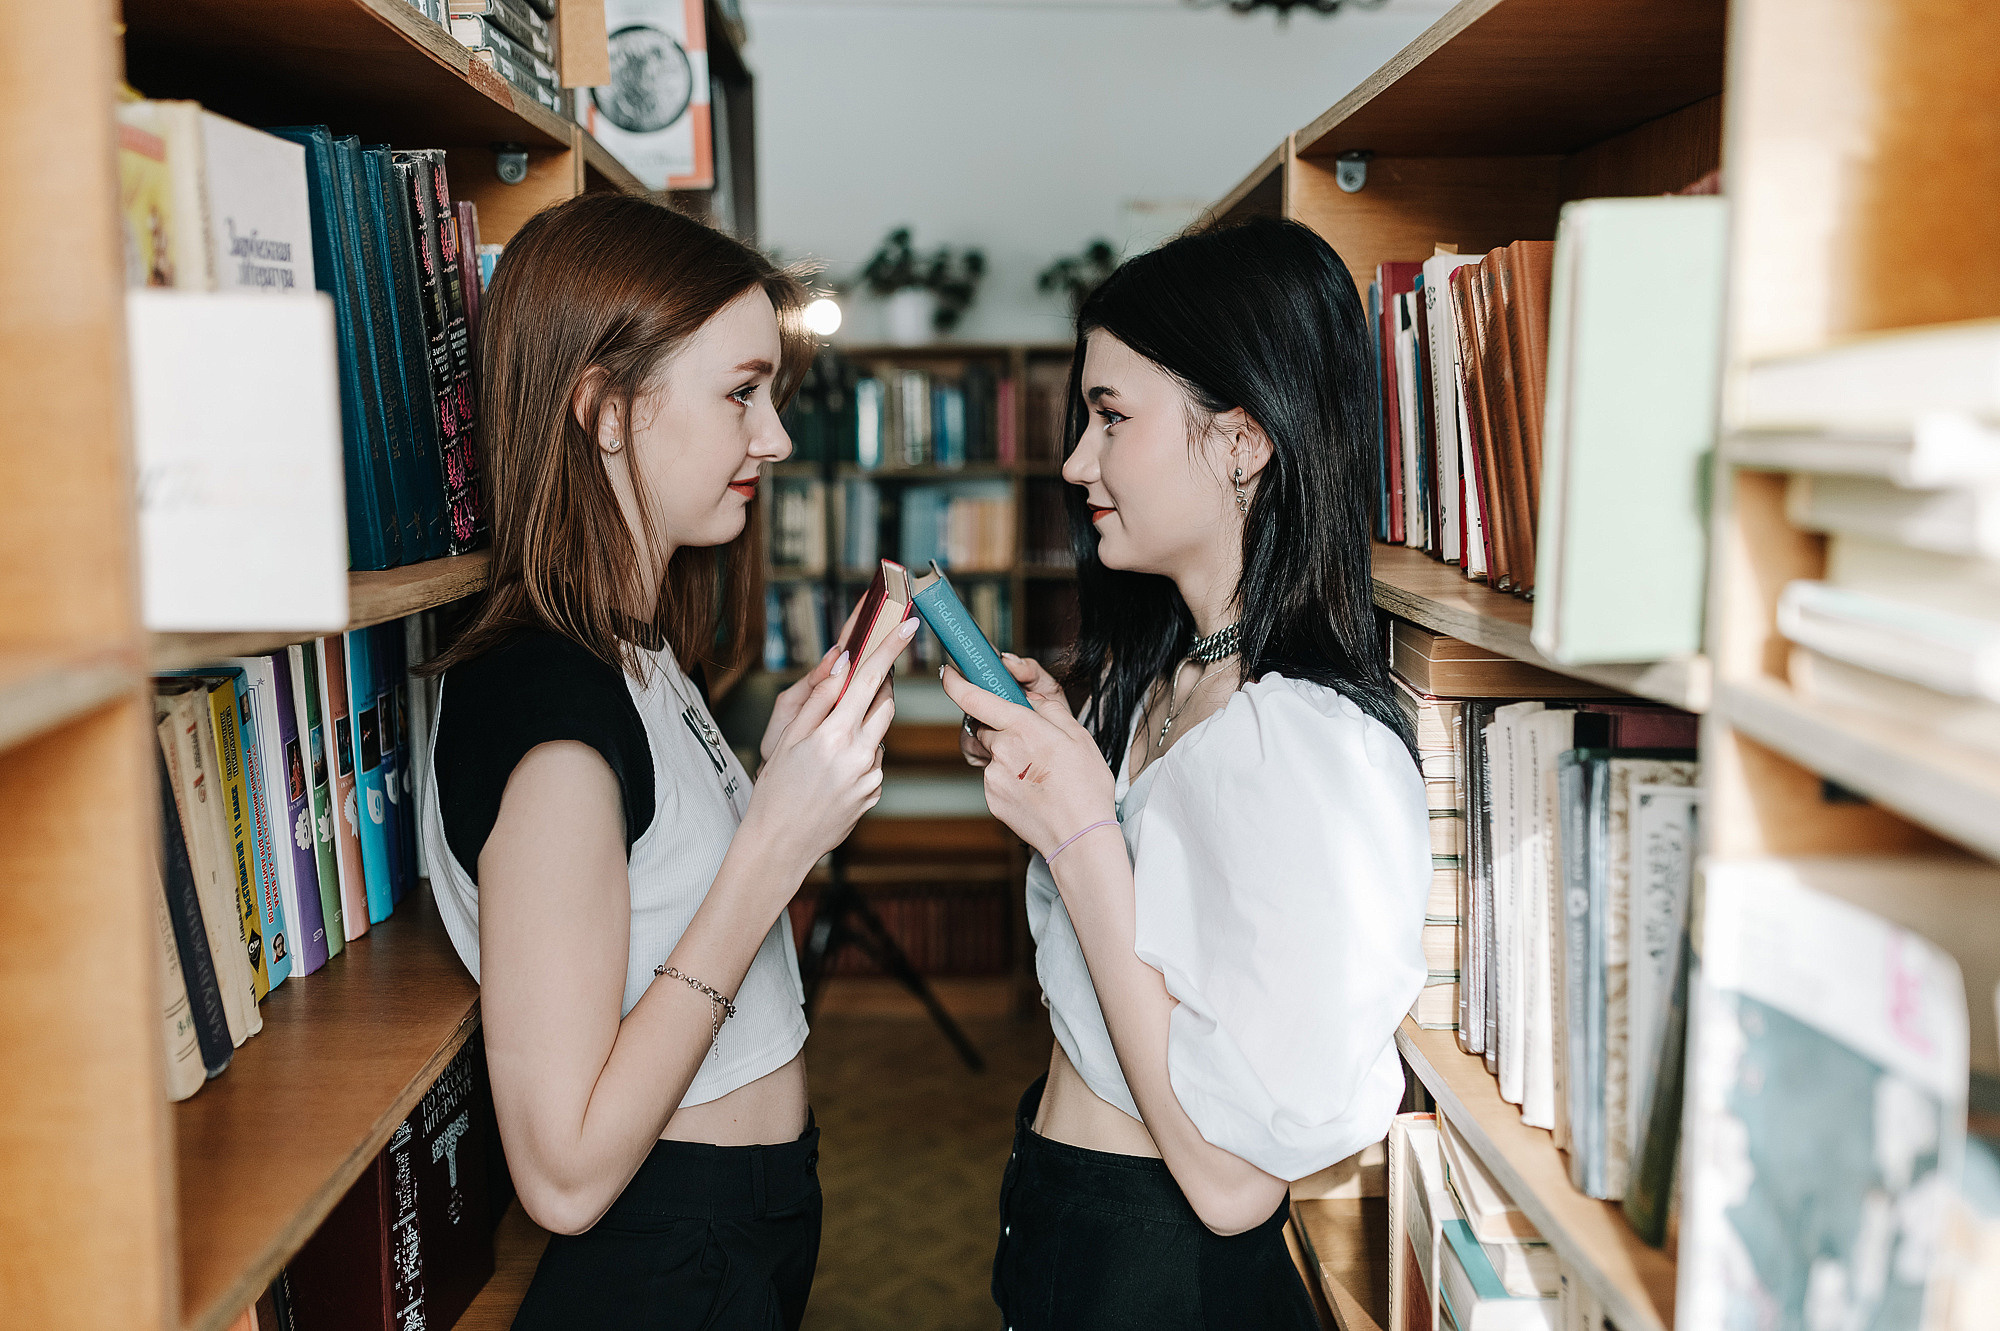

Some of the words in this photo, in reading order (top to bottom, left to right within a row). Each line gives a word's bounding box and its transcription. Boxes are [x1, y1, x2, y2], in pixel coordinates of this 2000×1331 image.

[225, 216, 292, 263] Зарубежная
[383, 181, 400, 275] ЛИТЕРАТУРЫ
[394, 279, 411, 354] МИРОВОЙ
[380, 358, 396, 430] ШЕДЕВРЫ
[405, 359, 421, 430] ШЕДЕВРЫ
[390, 434, 401, 459] ВСЕ
[414, 432, 425, 457] ВСЕ
[933, 599, 988, 671] ЛИТЕРАТУРЫ
[246, 748, 256, 791] УЧЕБНЫЙ
[252, 743, 263, 792] РУССКАЯ
[253, 792, 263, 838] МИНИМУМ
[259, 794, 272, 861] ЛИТЕРАТУРА
[302, 815, 309, 840] 5
[374, 797, 381, 817] 9
[234, 822, 243, 839] 11
[257, 838, 266, 858] ДЛЯ
[260, 858, 274, 924] АБИТУРИЕНТОВ
[268, 861, 276, 879] XIX
[271, 879, 280, 909] ВЕКА
[408, 1286, 414, 1302] 2
